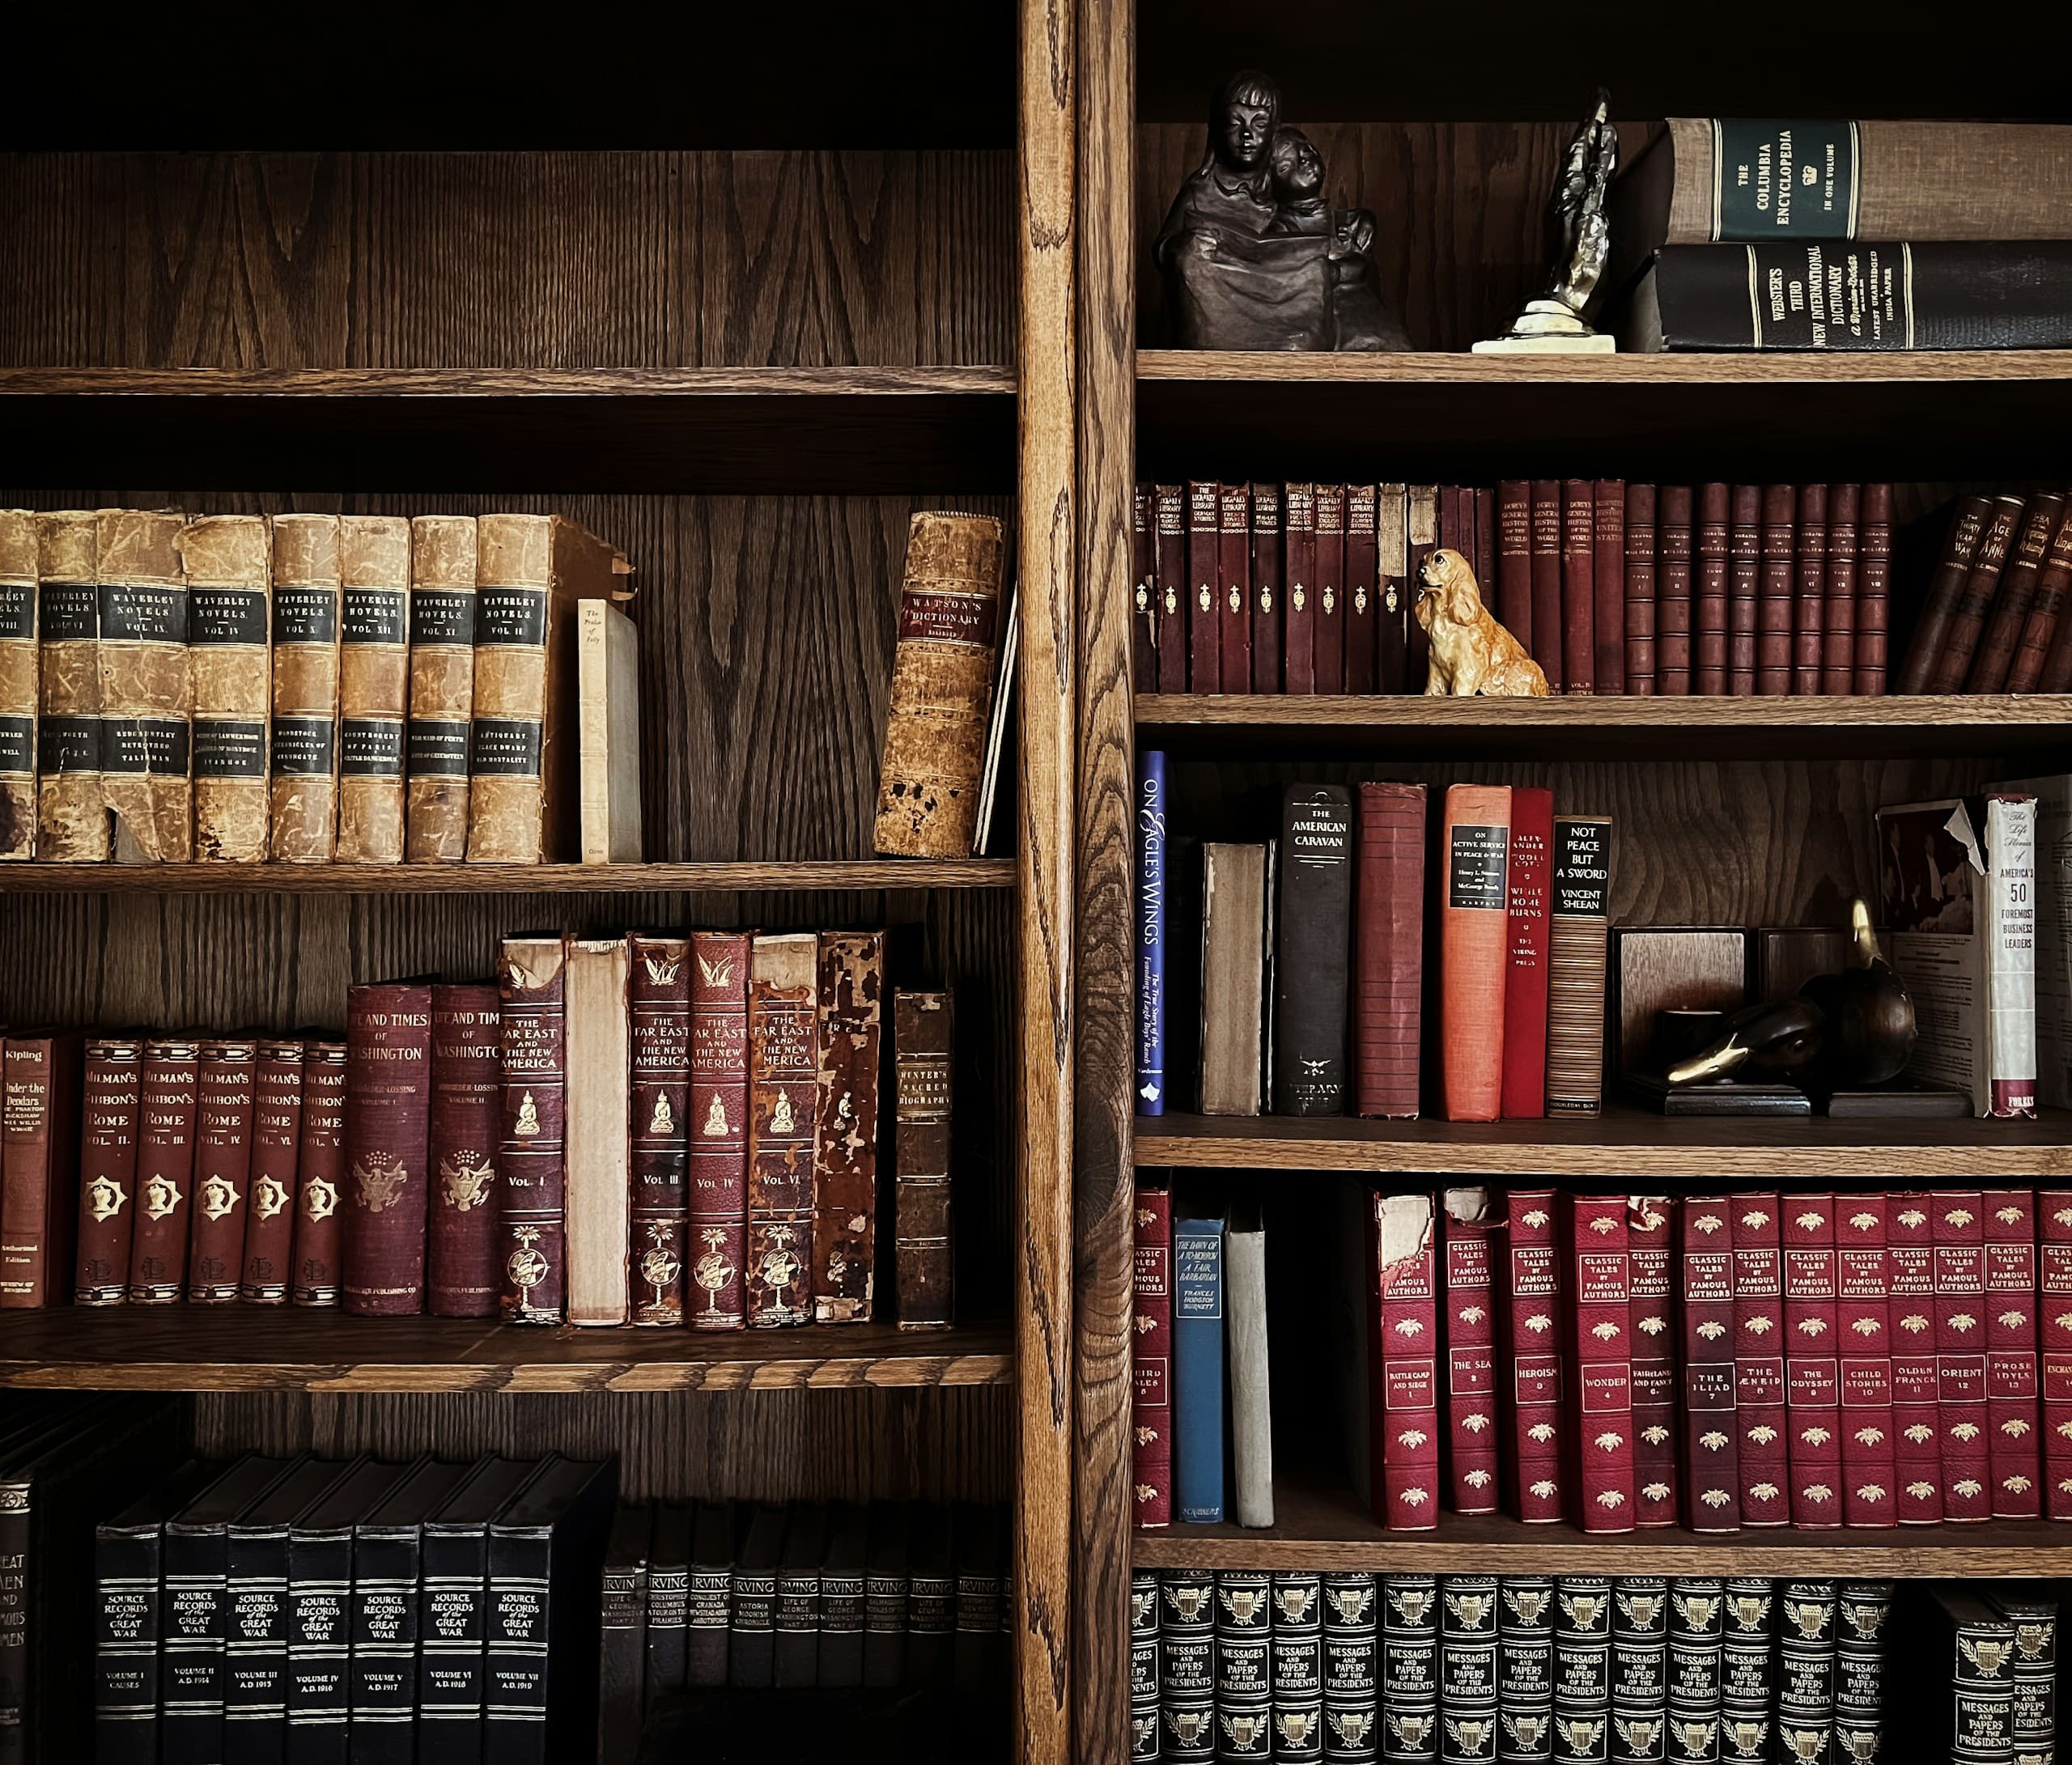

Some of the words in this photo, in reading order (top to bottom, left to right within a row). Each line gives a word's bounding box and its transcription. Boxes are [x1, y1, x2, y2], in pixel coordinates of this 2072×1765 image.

[1826, 143, 1834, 180] VOLUME
[1738, 164, 1748, 186] THE
[1757, 144, 1771, 210] COLUMBIA
[1777, 130, 1792, 225] ENCYCLOPEDIA
[1825, 181, 1833, 198] ONE
[1824, 202, 1832, 210] IN
[1807, 246, 1824, 320] INTERNATIONAL
[1870, 251, 1879, 306] UNABRIDGED
[1790, 281, 1804, 311] THIRD
[1828, 265, 1845, 325] DICTIONARY
[1812, 322, 1826, 346] NEW
[1987, 520, 2010, 537] AGE
[1955, 542, 1971, 558] WAR
[1979, 540, 2005, 558] ANNE
[113, 593, 174, 605] WAVERLEY
[195, 596, 252, 606] WAVERLEY
[278, 596, 329, 605] WAVERLEY
[346, 596, 401, 605] WAVERLEY
[484, 596, 535, 607] WAVERLEY
[913, 599, 981, 611] WATSON'S
[117, 606, 169, 617] NOVELS
[912, 613, 979, 625] DICTIONARY
[1144, 779, 1157, 807] ON
[1292, 821, 1347, 832] AMERICAN
[1571, 828, 1596, 838] NOT
[1139, 809, 1165, 878] EAGLE'S
[1295, 836, 1343, 846] CARAVAN
[1567, 841, 1600, 851] PEACE
[1572, 855, 1594, 864] BUT
[1556, 868, 1565, 877] A
[1568, 869, 1607, 879] SWORD
[2000, 868, 2033, 878] AMERICA'S
[1561, 889, 1602, 899] VINCENT
[2010, 884, 2026, 902] 50
[1564, 900, 1599, 910] SHEEAN
[1143, 880, 1161, 945] WINGS
[2002, 910, 2033, 919] FOREMOST
[2003, 924, 2032, 933] BUSINESS
[2005, 939, 2032, 948] LEADERS
[365, 1013, 388, 1026] AND
[392, 1013, 427, 1026] TIMES
[774, 1016, 794, 1025] THE
[376, 1031, 388, 1041] OF
[525, 1029, 558, 1038] EAST
[660, 1028, 689, 1036] EAST
[781, 1027, 813, 1035] EAST
[529, 1049, 552, 1057] NEW
[664, 1046, 686, 1054] NEW
[785, 1046, 807, 1054] NEW
[6, 1050, 42, 1062] Kipling
[635, 1057, 690, 1066] AMERICA
[29, 1083, 45, 1093] the
[6, 1096, 39, 1105] Deodars
[88, 1113, 129, 1126] ROME
[145, 1111, 185, 1126] ROME
[203, 1111, 240, 1126] ROME
[1183, 1263, 1191, 1272] A
[1194, 1263, 1212, 1272] FAIR
[1846, 1278, 1883, 1286] FAMOUS
[1843, 1286, 1887, 1294] AUTHORS
[1454, 1361, 1471, 1369] THE
[1941, 1368, 1982, 1377] ORIENT
[1586, 1378, 1627, 1387] WONDER
[1791, 1379, 1833, 1387] ODYSSEY
[1895, 1376, 1936, 1384] FRANCE
[733, 1580, 775, 1593] IRVING
[239, 1594, 275, 1603] SOURCE
[435, 1593, 470, 1602] SOURCE
[235, 1604, 278, 1613] RECORDS
[240, 1619, 273, 1627] GREAT
[244, 1628, 269, 1637] WAR
[1389, 1648, 1432, 1659] MESSAGES
[235, 1671, 267, 1679] VOLUME
[1395, 1665, 1427, 1675] PAPERS
[383, 1683, 398, 1691] 1917
[1387, 1680, 1434, 1691] PRESIDENTS
[1962, 1701, 2009, 1714] MESSAGES
[1968, 1719, 2004, 1730] PAPERS
[1959, 1734, 2011, 1746] PRESIDENTS
